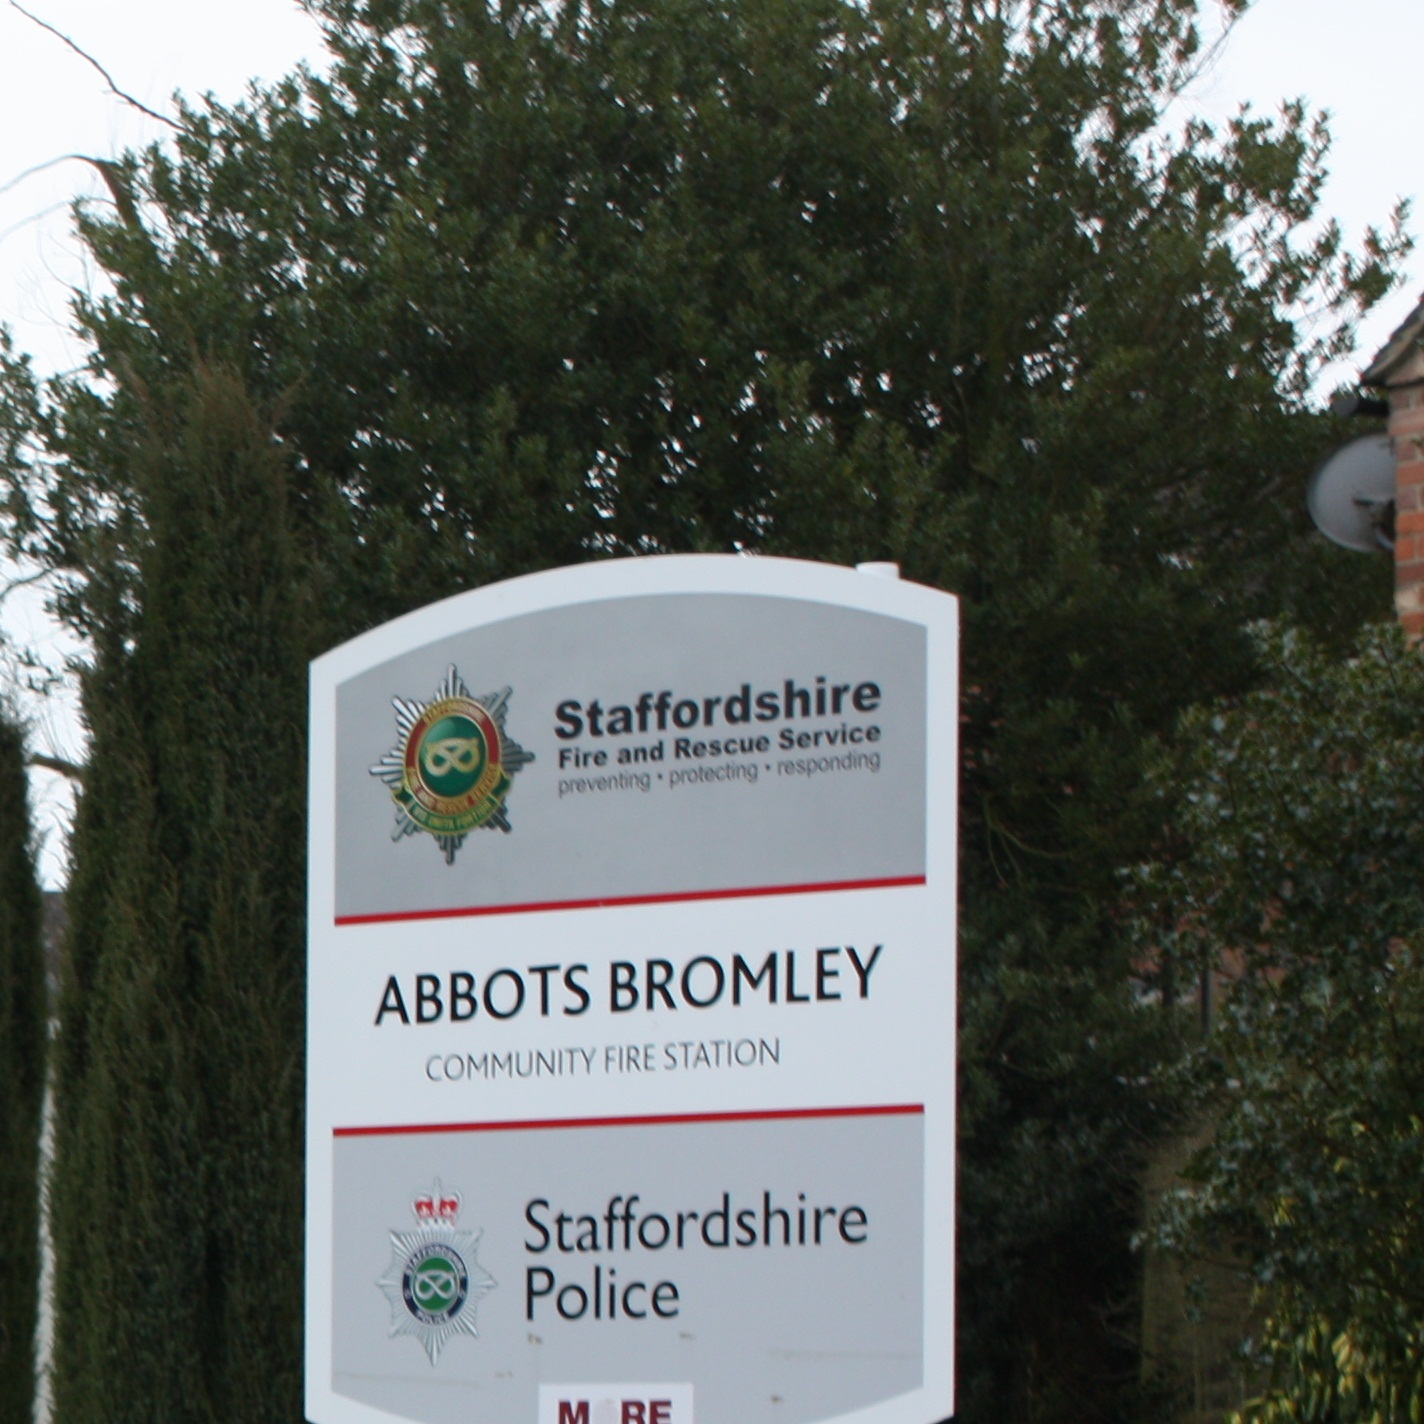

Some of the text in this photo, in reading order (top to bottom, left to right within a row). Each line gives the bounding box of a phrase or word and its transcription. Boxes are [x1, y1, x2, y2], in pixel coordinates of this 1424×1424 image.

[554, 675, 881, 741] Staffordshire
[558, 750, 880, 799] preventing protecting responding
[559, 722, 881, 770] Fire and Rescue Service
[374, 943, 884, 1027] ABBOTS BROMLEY
[425, 1036, 780, 1082] COMMUNITY FIRE STATION
[524, 1190, 868, 1254] Staffordshire
[525, 1264, 680, 1322] Police
